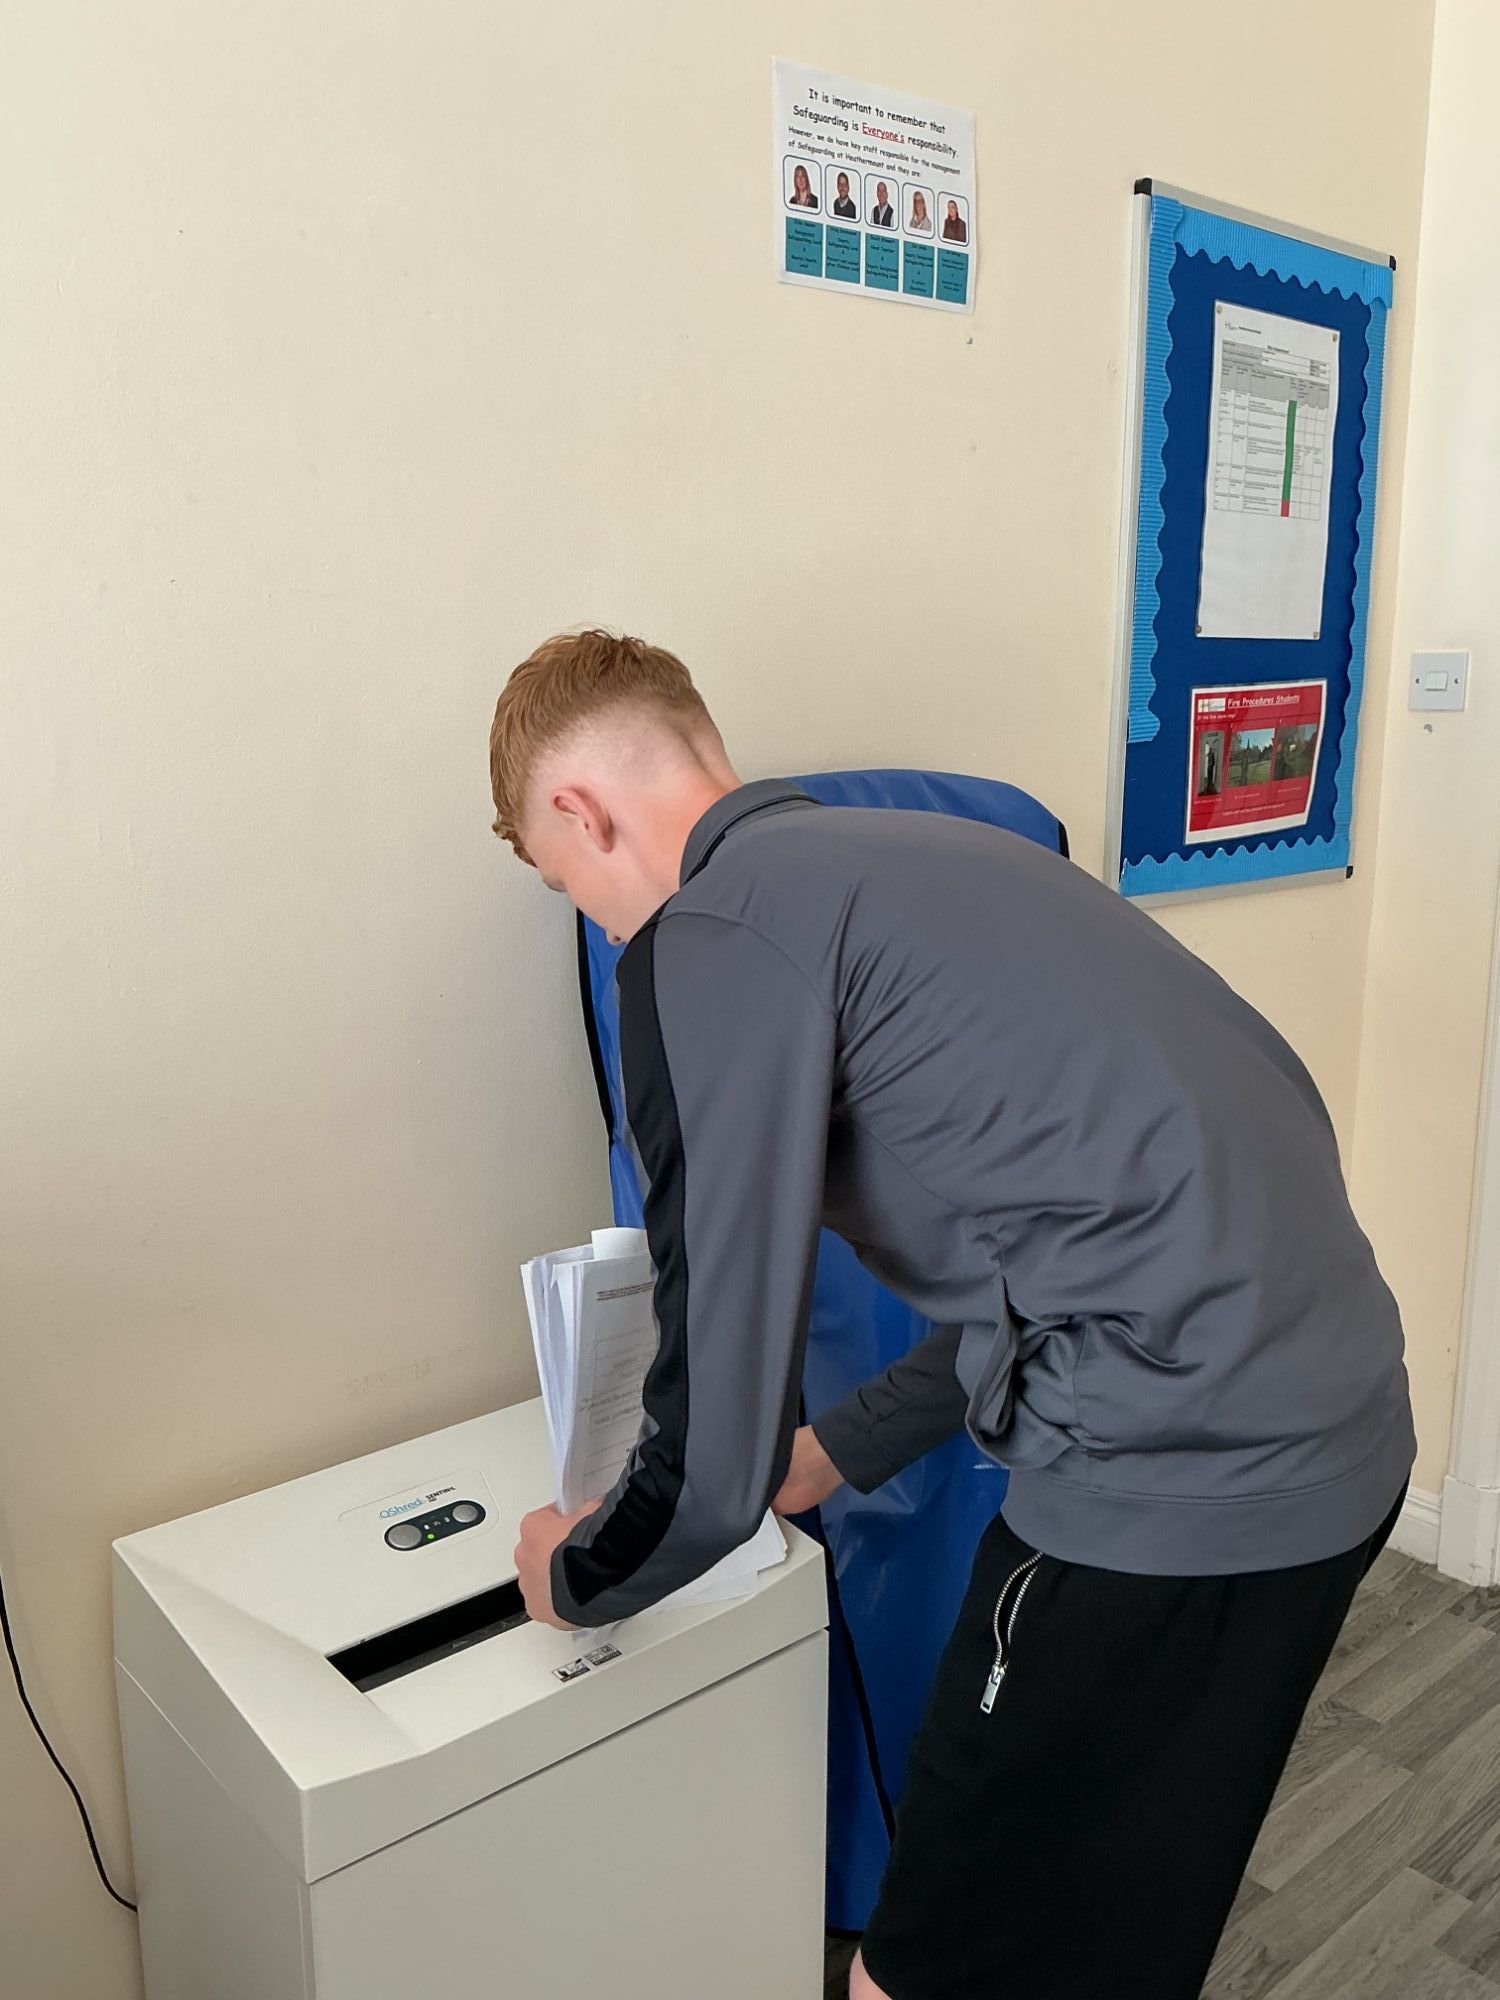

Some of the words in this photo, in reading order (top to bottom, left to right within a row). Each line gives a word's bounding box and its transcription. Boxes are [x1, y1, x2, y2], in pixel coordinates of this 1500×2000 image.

[809, 88, 818, 100] It
[822, 92, 829, 103] is
[832, 95, 872, 115] important
[875, 107, 884, 118] to
[887, 112, 927, 128] remember
[929, 121, 946, 134] that
[793, 105, 849, 132] Safeguarding
[851, 120, 859, 131] is
[862, 122, 905, 144] Everyone's
[907, 136, 959, 159] responsibility.
[788, 140, 795, 148] of
[797, 141, 835, 159] Safeguarding
[886, 163, 896, 171] and
[897, 165, 910, 176] they
[835, 137, 849, 147] have
[851, 140, 861, 152] key
[862, 144, 878, 154] staff
[879, 149, 909, 162] responsible
[911, 155, 919, 164] for
[921, 158, 930, 167] the
[931, 162, 961, 175] management
[1228, 698, 1240, 708] Fire
[1242, 697, 1274, 707] Procedures
[1276, 694, 1300, 704] Students
[379, 1498, 424, 1519] QShred
